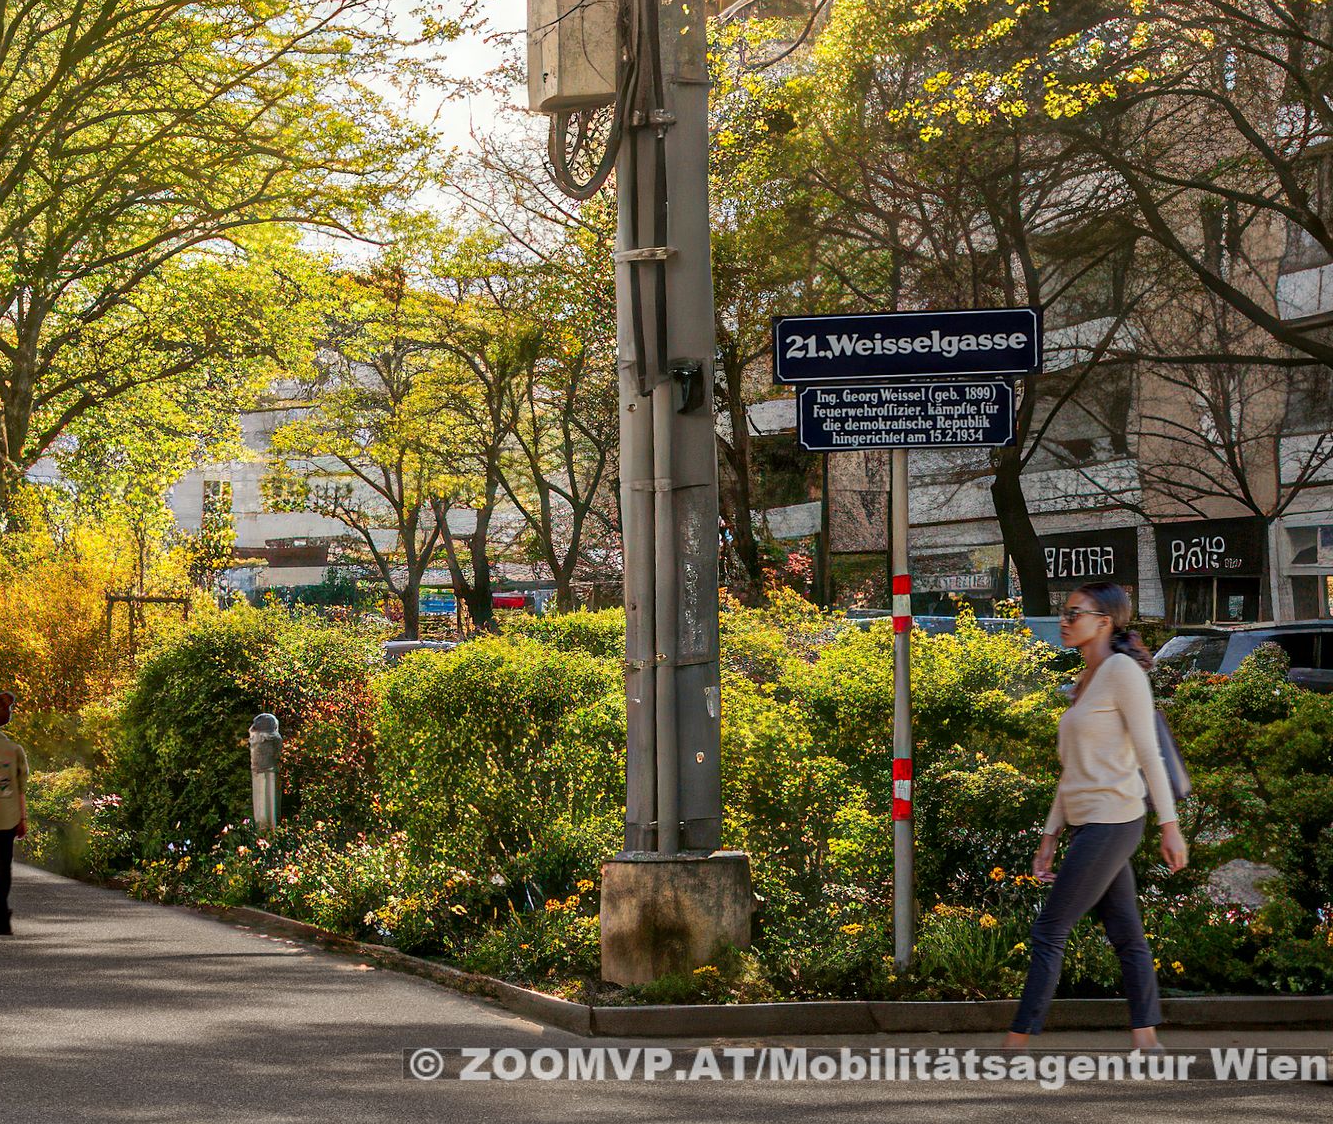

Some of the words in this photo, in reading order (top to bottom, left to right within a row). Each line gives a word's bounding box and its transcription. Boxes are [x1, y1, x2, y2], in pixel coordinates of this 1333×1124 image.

[816, 390, 840, 406] Ing.
[842, 389, 879, 404] Georg
[881, 387, 926, 401] Weissel
[928, 384, 960, 403] (geb.
[964, 383, 997, 402] 1899)
[927, 403, 979, 420] kämpfte
[980, 401, 999, 415] für
[822, 418, 842, 432] die
[844, 416, 934, 431] demokratische
[936, 415, 991, 432] Republik
[832, 431, 906, 447] hingerichtet
[906, 432, 927, 443] am
[929, 429, 984, 442] 15.2.1934
